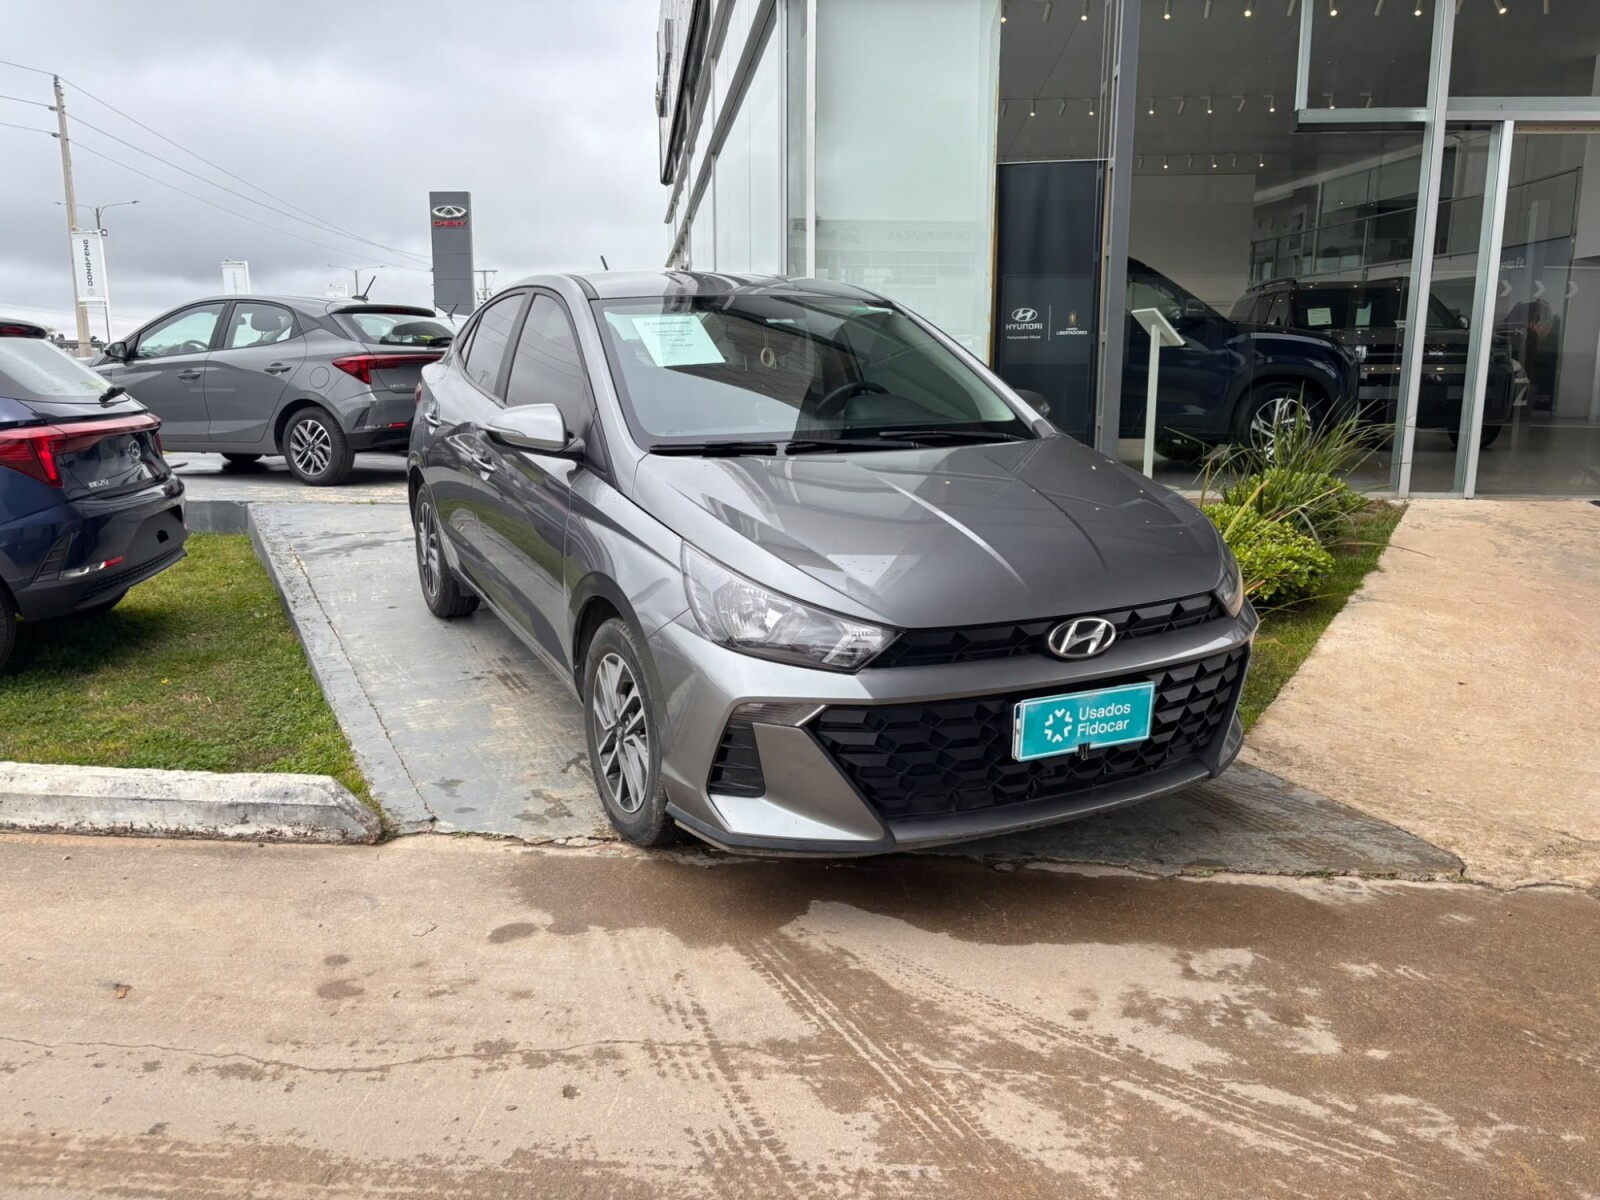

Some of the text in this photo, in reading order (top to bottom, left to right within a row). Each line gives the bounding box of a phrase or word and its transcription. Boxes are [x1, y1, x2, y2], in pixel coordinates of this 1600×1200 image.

[433, 220, 465, 228] CHERY
[83, 239, 93, 286] DONGFENG
[1078, 703, 1131, 721] Usados
[1076, 719, 1130, 737] Fidocar
